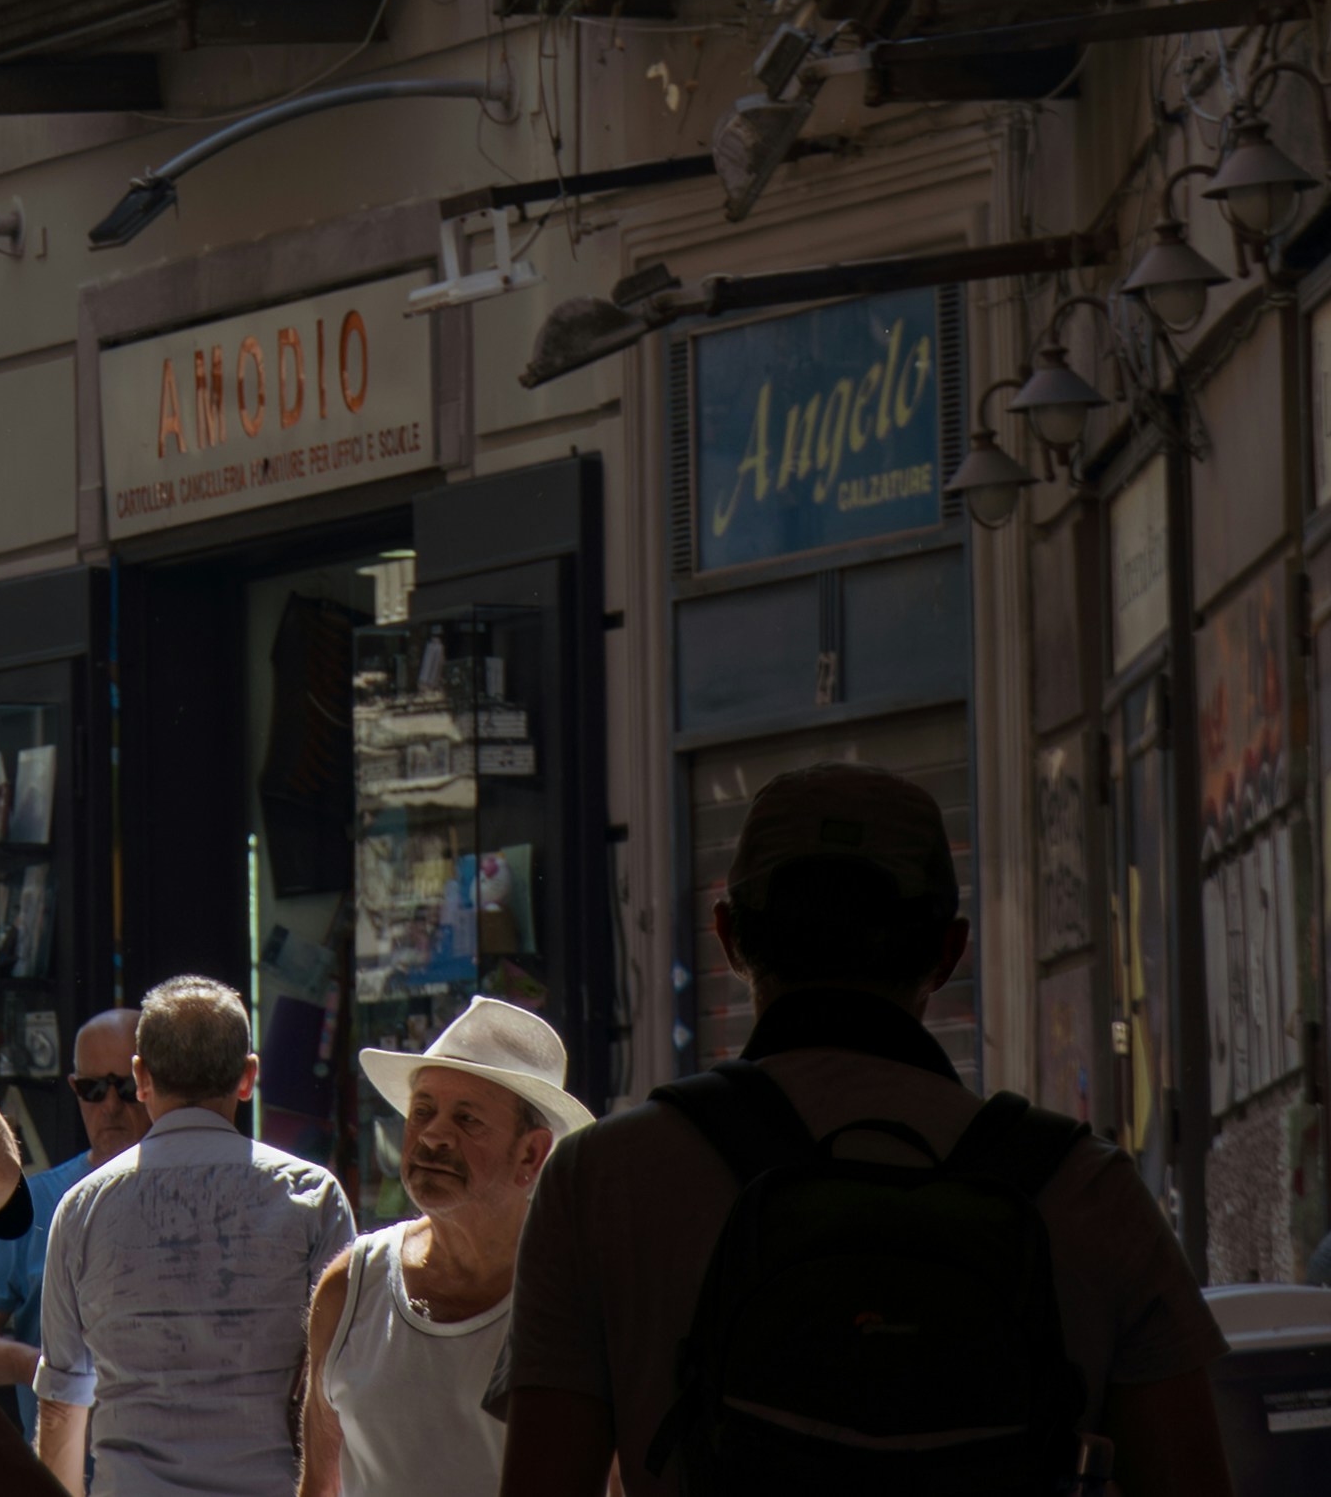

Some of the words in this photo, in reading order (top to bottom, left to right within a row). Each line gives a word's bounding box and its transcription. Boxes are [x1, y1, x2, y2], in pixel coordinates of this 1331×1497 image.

[158, 309, 368, 459] AMODIO
[712, 317, 931, 537] Angelo
[309, 443, 330, 475] PER
[839, 463, 933, 511] CALZATURE
